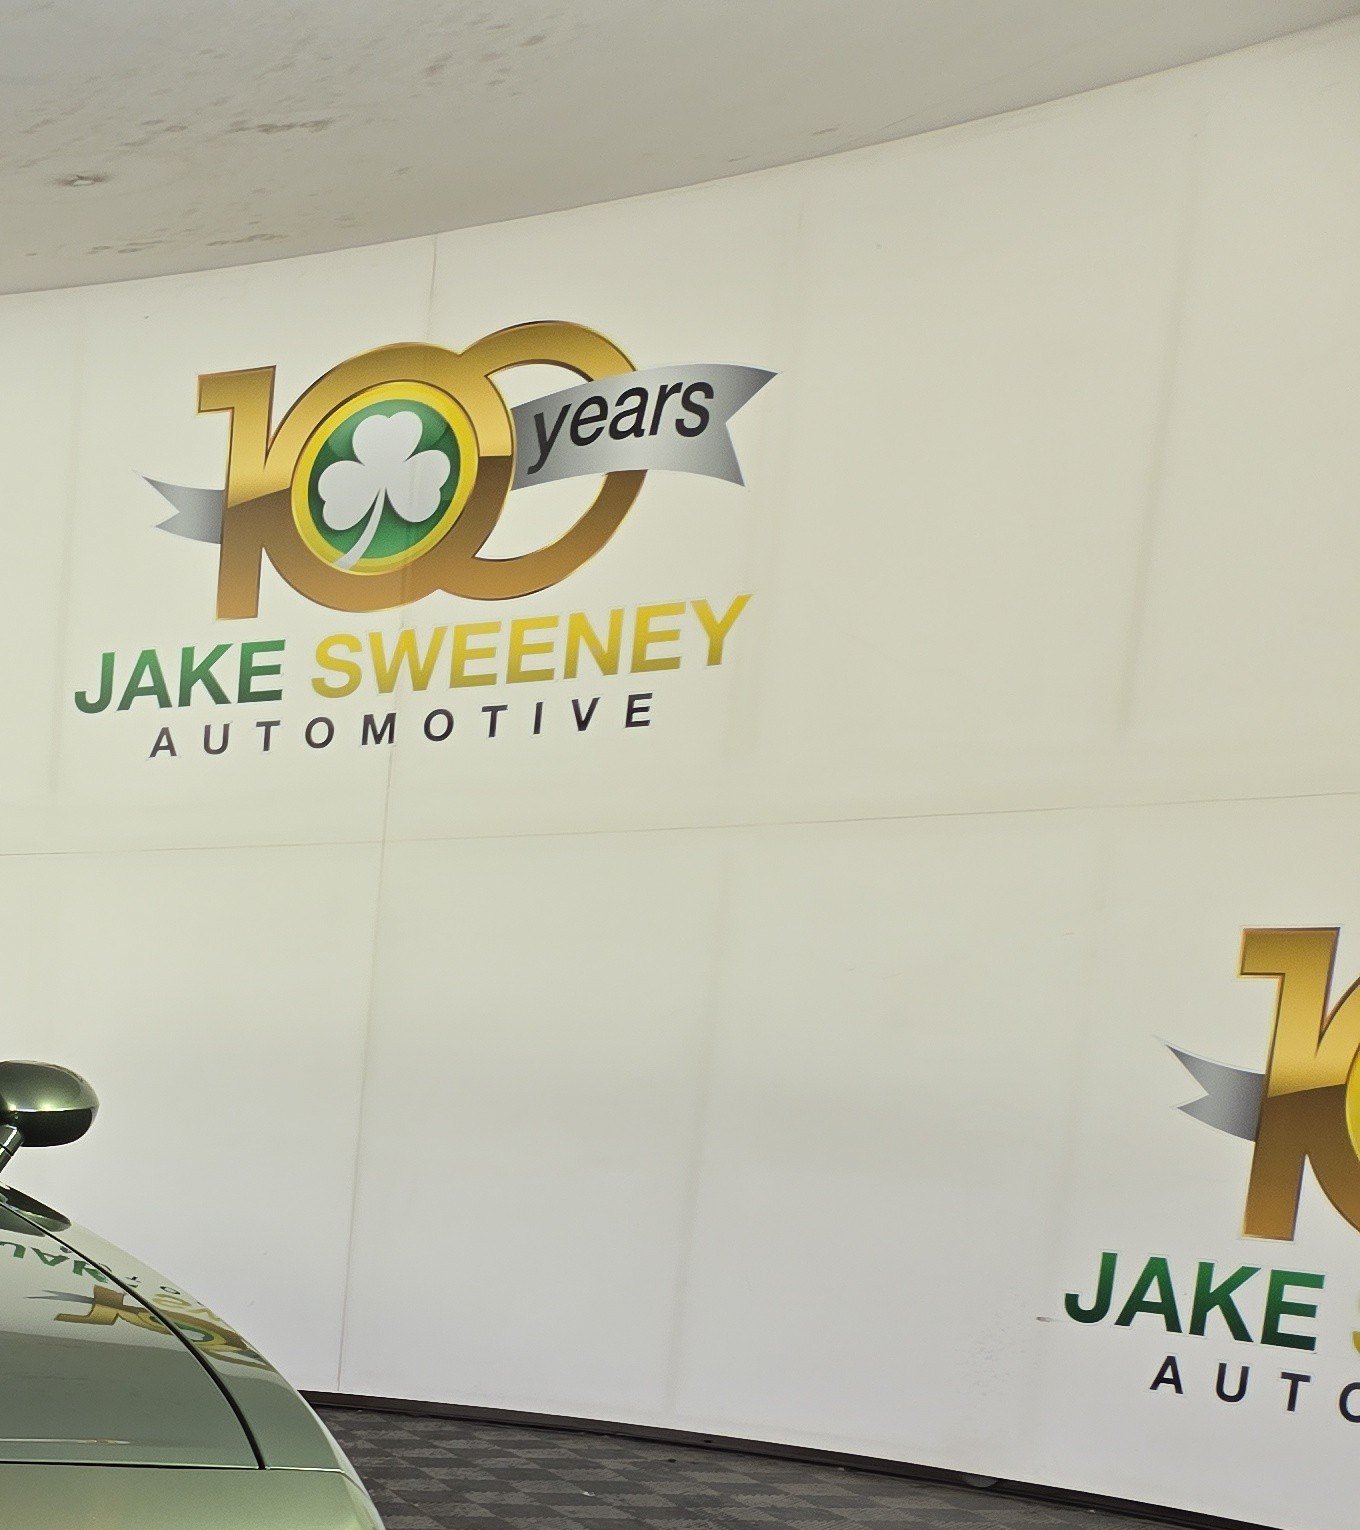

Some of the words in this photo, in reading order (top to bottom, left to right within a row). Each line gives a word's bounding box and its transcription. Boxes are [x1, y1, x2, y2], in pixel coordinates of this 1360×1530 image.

[197, 320, 649, 620] 100
[527, 381, 713, 474] years
[75, 640, 286, 714] JAKE
[311, 593, 753, 698] SWEENEY
[149, 692, 654, 758] AUTOMOTIVE
[1064, 1252, 1326, 1352] JAKE
